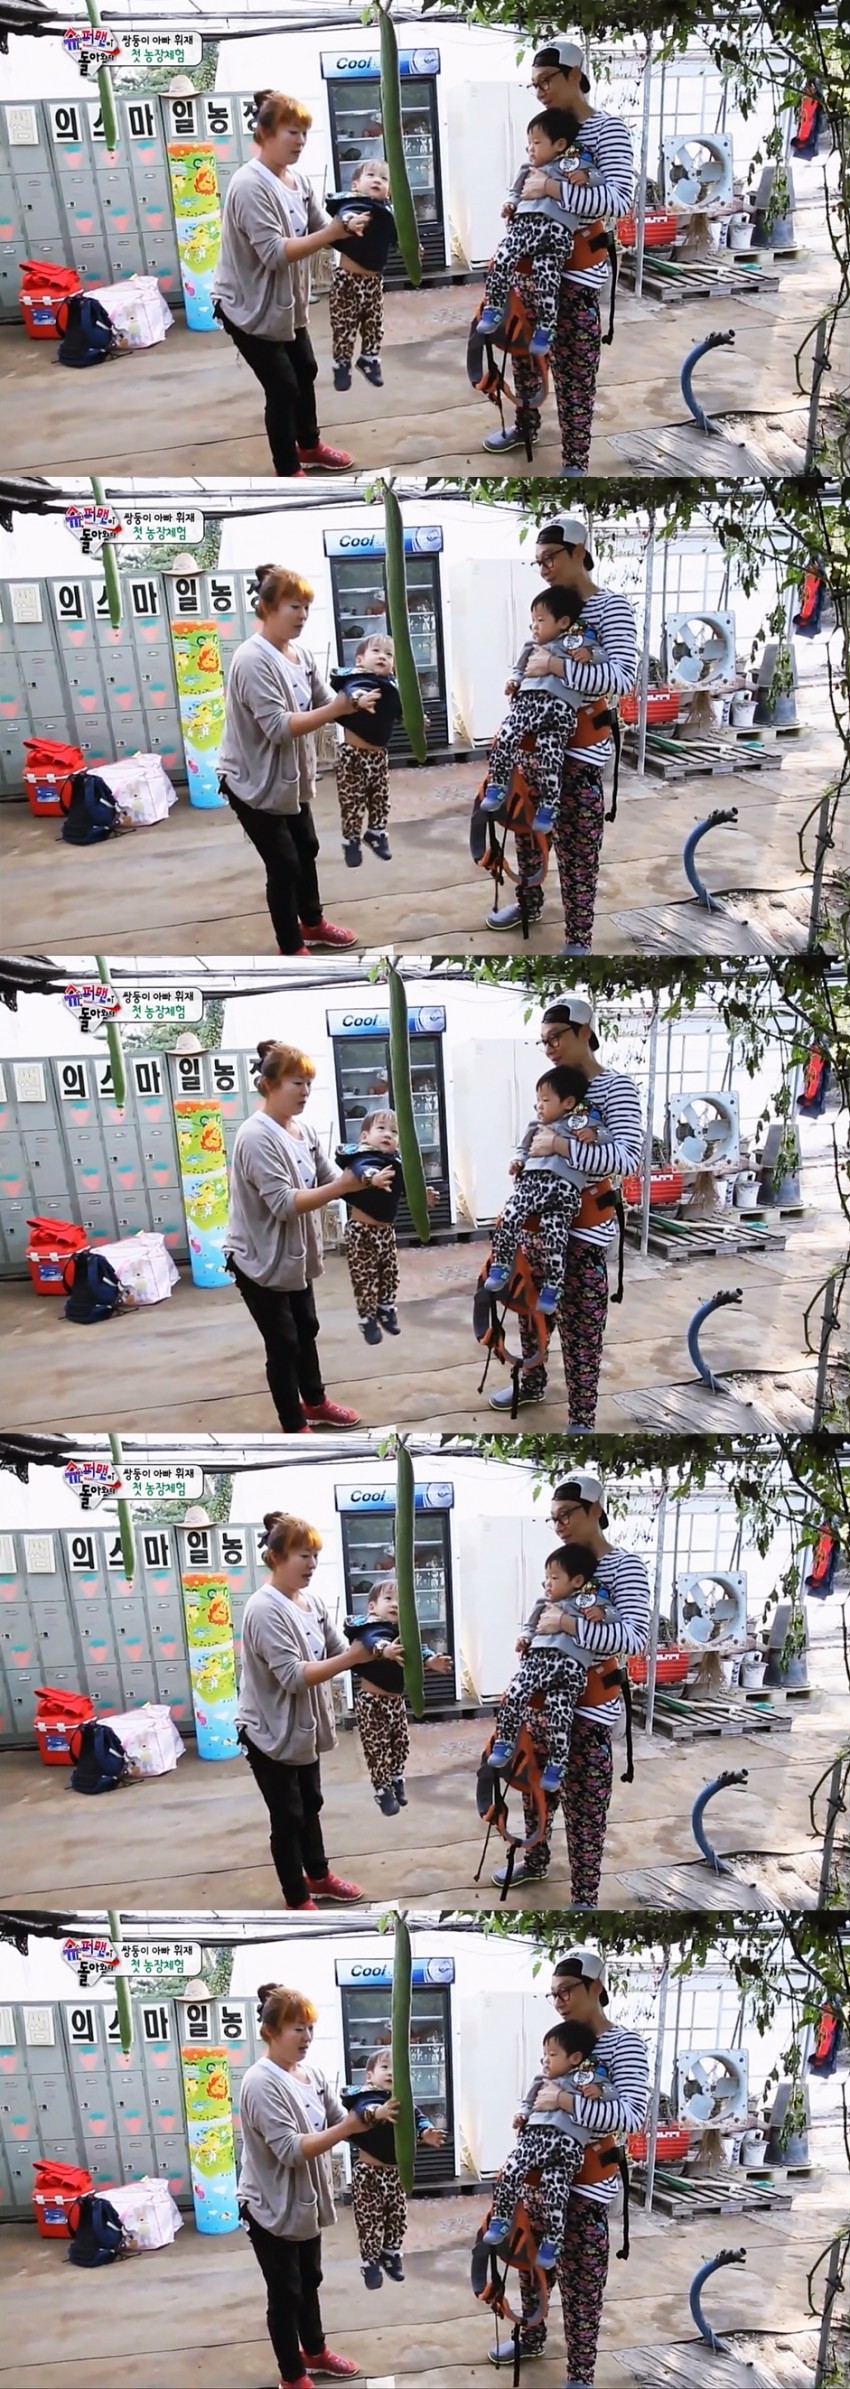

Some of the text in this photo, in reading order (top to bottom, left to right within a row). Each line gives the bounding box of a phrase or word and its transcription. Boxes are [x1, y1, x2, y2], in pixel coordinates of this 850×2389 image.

[336, 56, 372, 70] Cool
[339, 534, 375, 548] Cool
[342, 1014, 378, 1027] Cool
[350, 1489, 386, 1502] Cool
[351, 1964, 387, 1977] Cool
